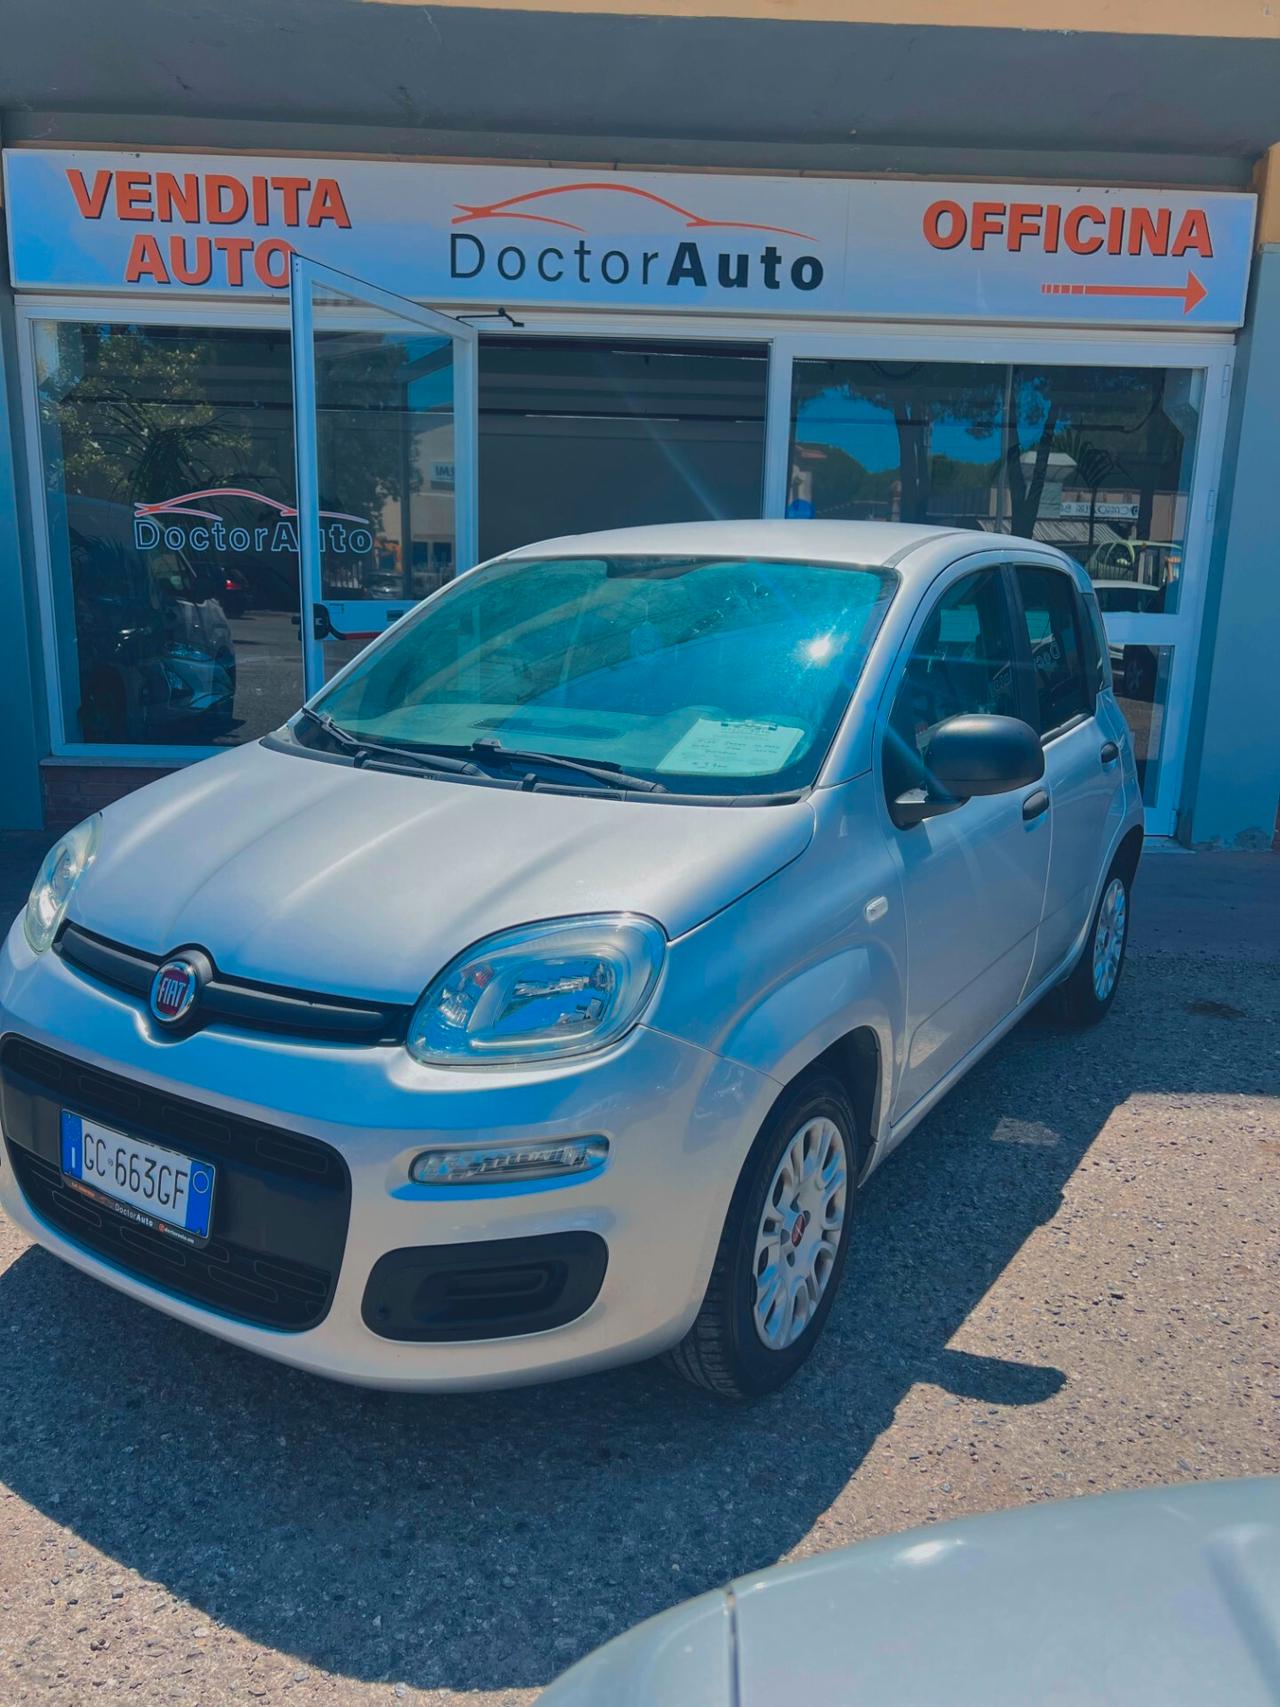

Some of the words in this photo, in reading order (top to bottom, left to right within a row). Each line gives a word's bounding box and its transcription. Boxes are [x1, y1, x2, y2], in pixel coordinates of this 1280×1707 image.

[66, 169, 352, 228] VENDITA
[922, 200, 1213, 257] OFFICINA
[124, 234, 298, 288] AUTO
[450, 233, 824, 291] DoctorAuto
[134, 519, 373, 554] DoctorAto
[158, 977, 187, 1007] FIAT
